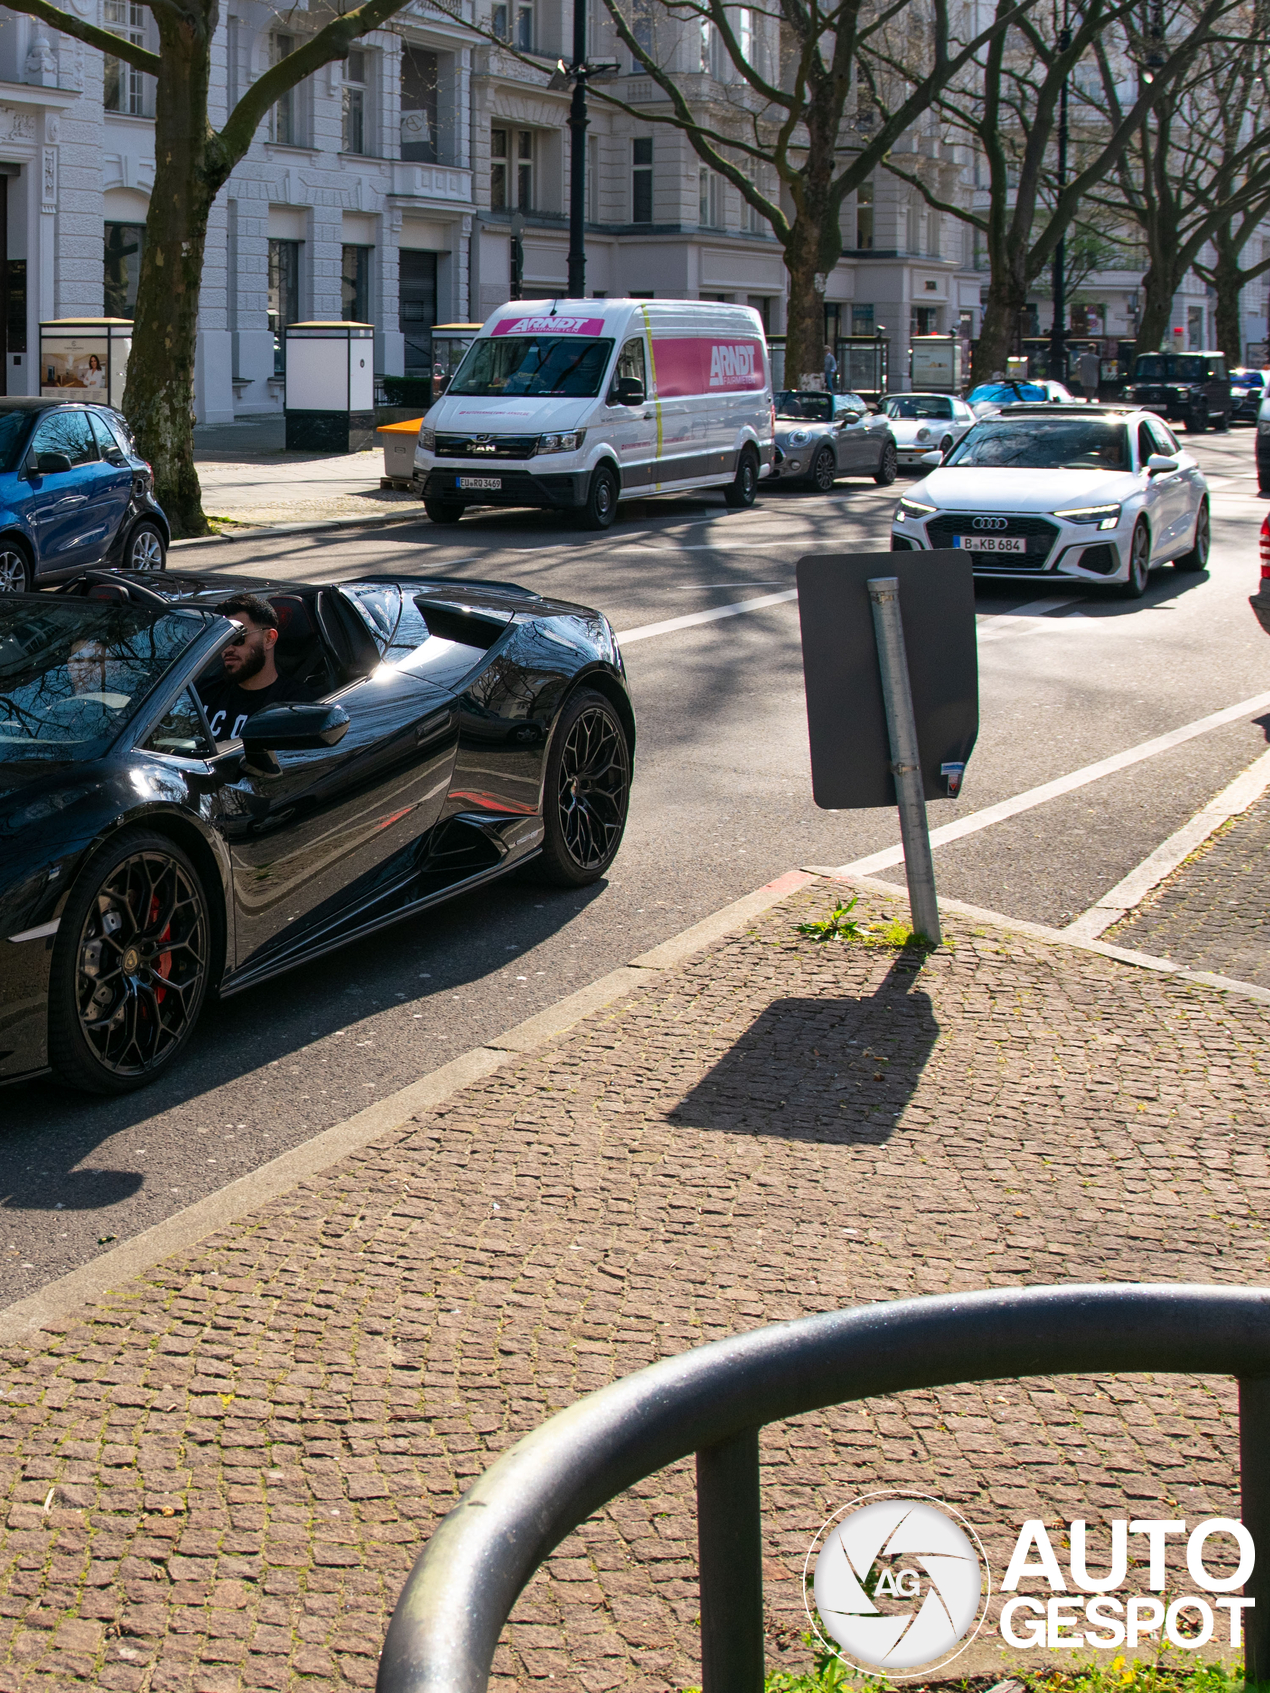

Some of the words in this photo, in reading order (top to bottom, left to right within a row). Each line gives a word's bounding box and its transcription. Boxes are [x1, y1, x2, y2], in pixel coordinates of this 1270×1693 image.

[506, 317, 590, 334] ARNDT
[709, 345, 755, 386] ARNDT
[466, 444, 496, 452] MAN
[483, 479, 501, 488] 3469
[964, 538, 972, 549] B
[980, 538, 997, 550] KB
[998, 539, 1020, 551] 684
